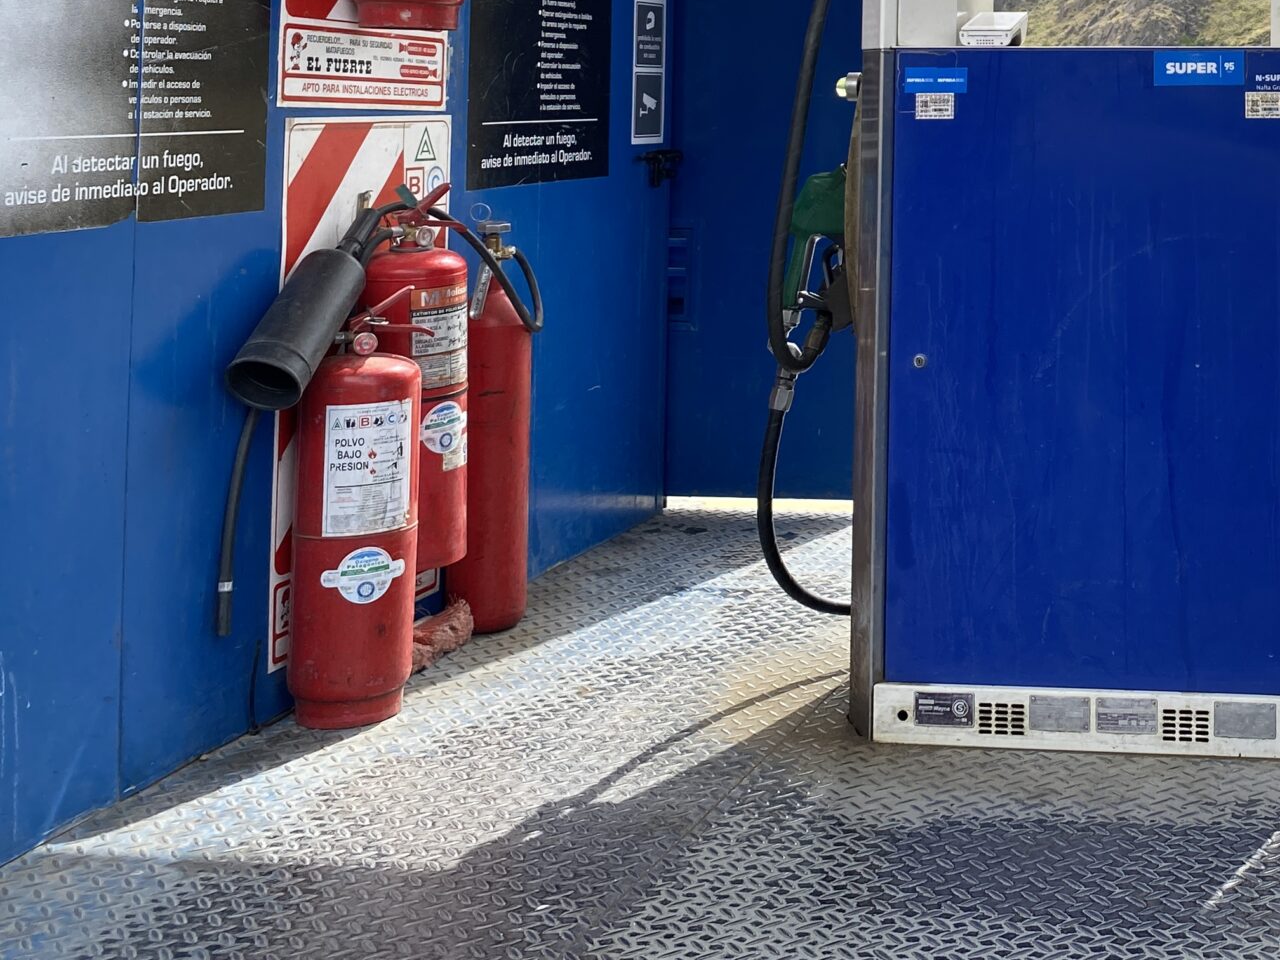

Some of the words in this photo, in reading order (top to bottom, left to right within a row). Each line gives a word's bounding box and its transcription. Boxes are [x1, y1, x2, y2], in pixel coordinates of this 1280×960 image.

[169, 21, 206, 33] disposición
[175, 51, 211, 60] evacuación
[307, 57, 321, 71] EL
[326, 58, 372, 74] FUERTE
[1166, 62, 1217, 74] SUPER
[1224, 62, 1235, 71] 95
[167, 81, 190, 89] acceso
[192, 80, 200, 88] de
[302, 83, 319, 92] APTO
[323, 84, 340, 93] PARA
[342, 85, 391, 96] INSTALACIONES
[394, 87, 428, 97] ELECTRICAS
[170, 95, 201, 105] personas
[144, 110, 173, 119] estación
[175, 109, 183, 118] de
[185, 108, 212, 118] servicio.
[503, 134, 512, 147] Al
[513, 134, 544, 147] detectar
[546, 134, 555, 145] un
[556, 132, 577, 146] fuego,
[420, 139, 431, 155] A
[51, 155, 68, 174] Al
[73, 155, 135, 173] detectar
[142, 155, 158, 169] un
[163, 149, 203, 172] fuego,
[481, 154, 502, 169] avise
[503, 153, 513, 167] de
[514, 151, 549, 166] inmediato
[551, 150, 558, 164] al
[559, 149, 592, 164] Operador.
[5, 185, 47, 206] avise
[52, 184, 70, 203] de
[75, 178, 148, 201] inmediato
[152, 177, 164, 195] al
[168, 173, 233, 198] Operador.
[409, 177, 420, 195] B
[361, 418, 370, 426] B
[335, 438, 365, 447] POLVO
[337, 450, 362, 459] BAJO
[330, 461, 369, 471] PRESION
